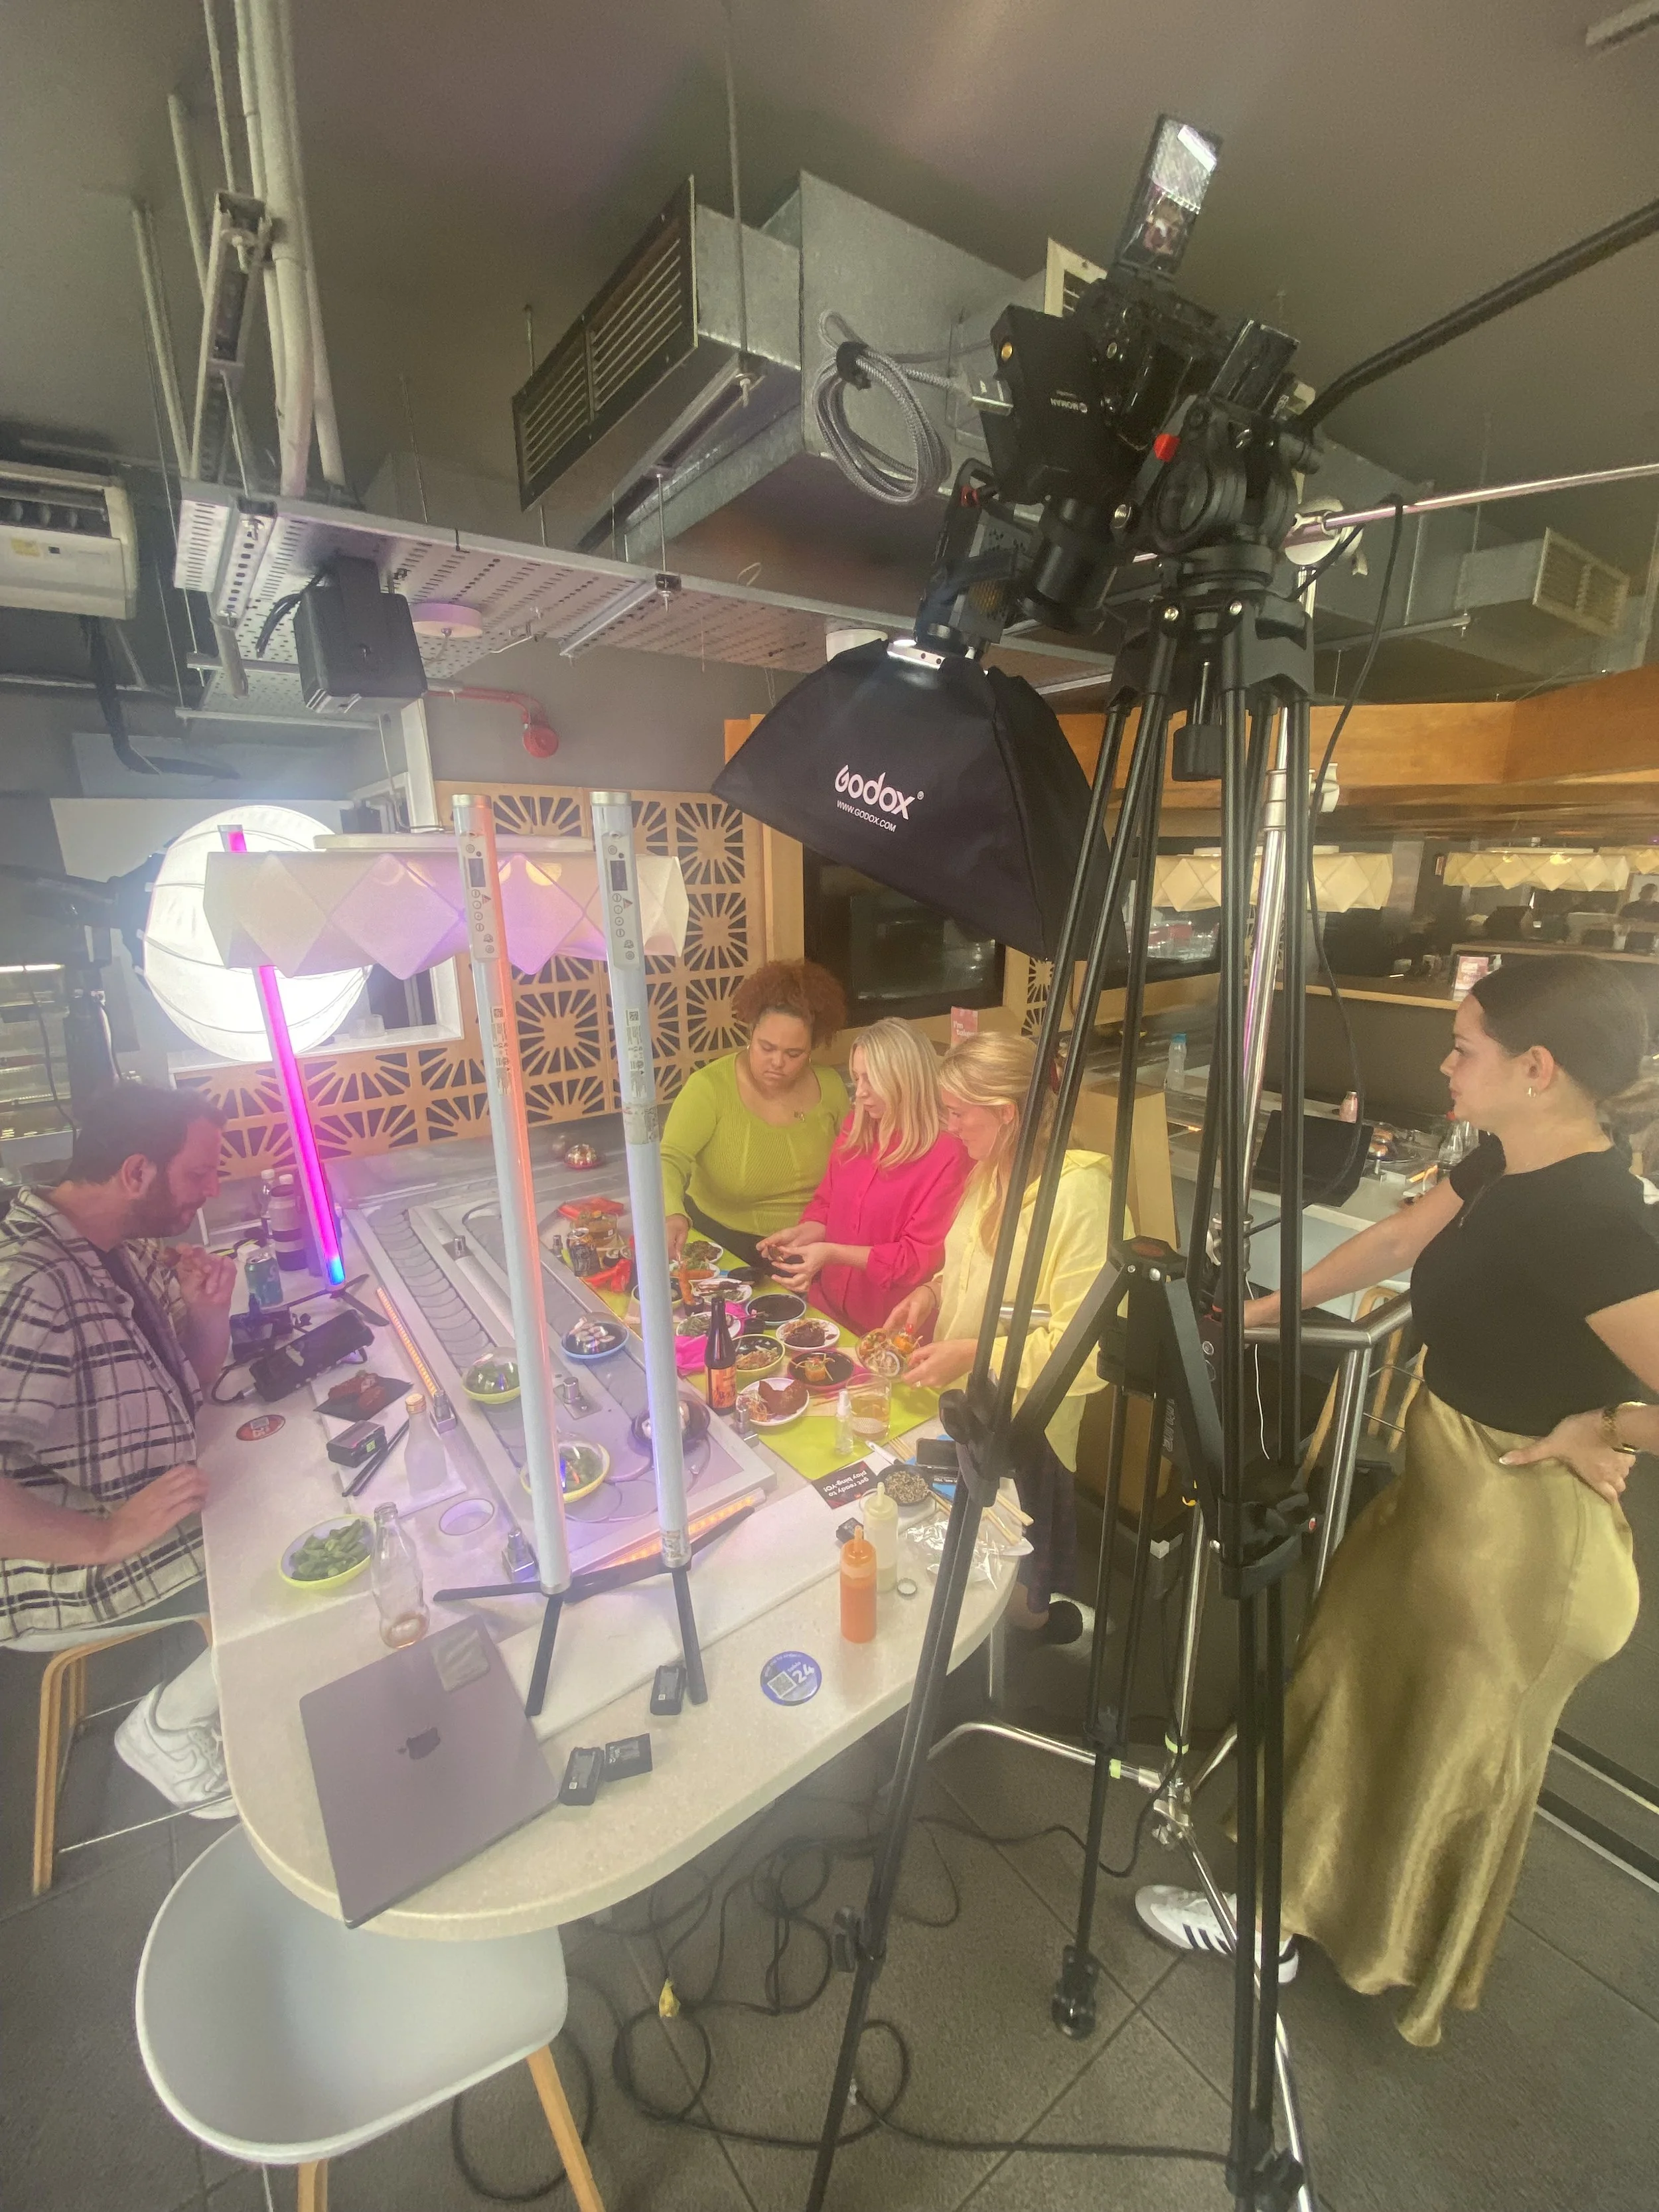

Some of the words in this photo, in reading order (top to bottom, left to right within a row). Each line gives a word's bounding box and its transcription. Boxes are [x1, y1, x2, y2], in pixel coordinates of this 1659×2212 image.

[835, 765, 915, 820] Godox
[837, 800, 897, 832] WWW.GODOX.COM
[853, 1470, 867, 1479] play
[857, 1477, 869, 1485] get
[824, 1477, 853, 1493] bing-YO!
[838, 1483, 857, 1493] ready
[792, 1664, 815, 1684] 24
